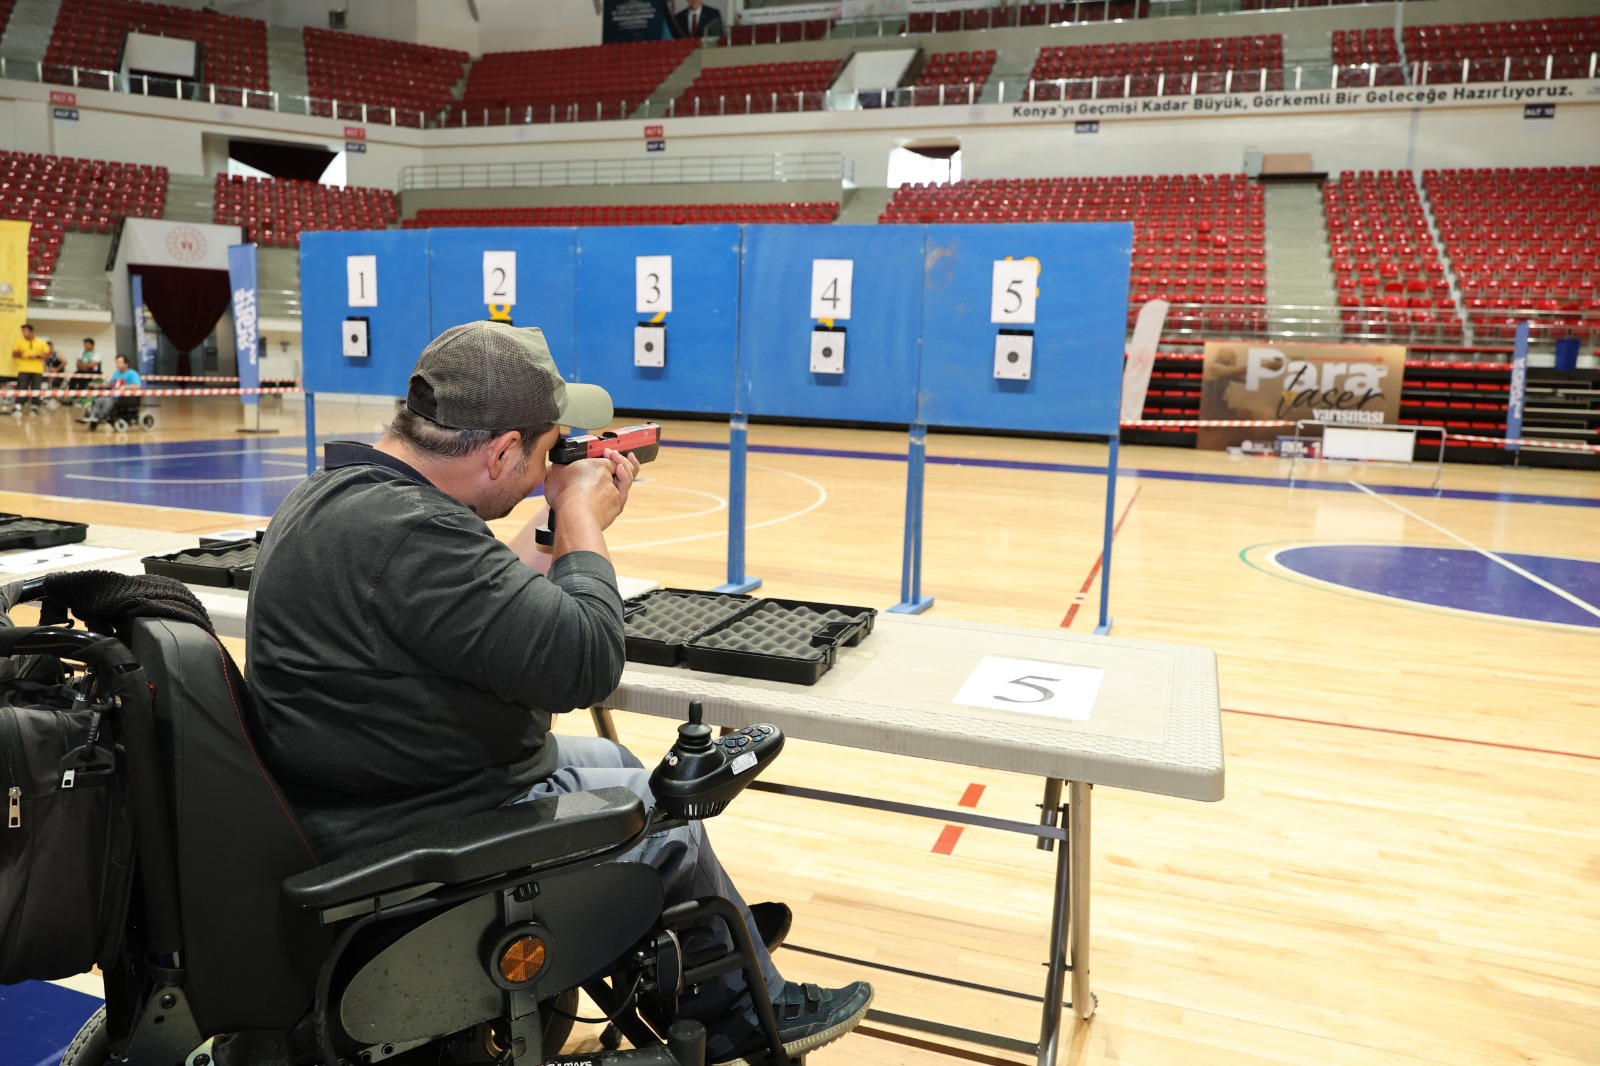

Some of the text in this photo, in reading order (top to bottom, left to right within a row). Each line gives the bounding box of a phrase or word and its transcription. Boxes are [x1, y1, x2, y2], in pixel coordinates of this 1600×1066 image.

[1012, 103, 1075, 119] Konya'yı
[1079, 100, 1138, 116] Geçmişi
[1142, 99, 1188, 113] Kadar
[1193, 96, 1248, 111] Büyük,
[1253, 90, 1330, 108] Görkemli
[1335, 92, 1361, 105] Bir
[1366, 87, 1447, 104] Geleceğe
[1453, 84, 1574, 102] Hazırlıyoruz.
[358, 271, 366, 299] 1
[493, 268, 505, 296] 2
[646, 273, 661, 304] 3
[821, 277, 841, 310] 4
[1004, 279, 1023, 314] 5
[1246, 349, 1381, 396] Para
[992, 674, 1064, 704] 5
